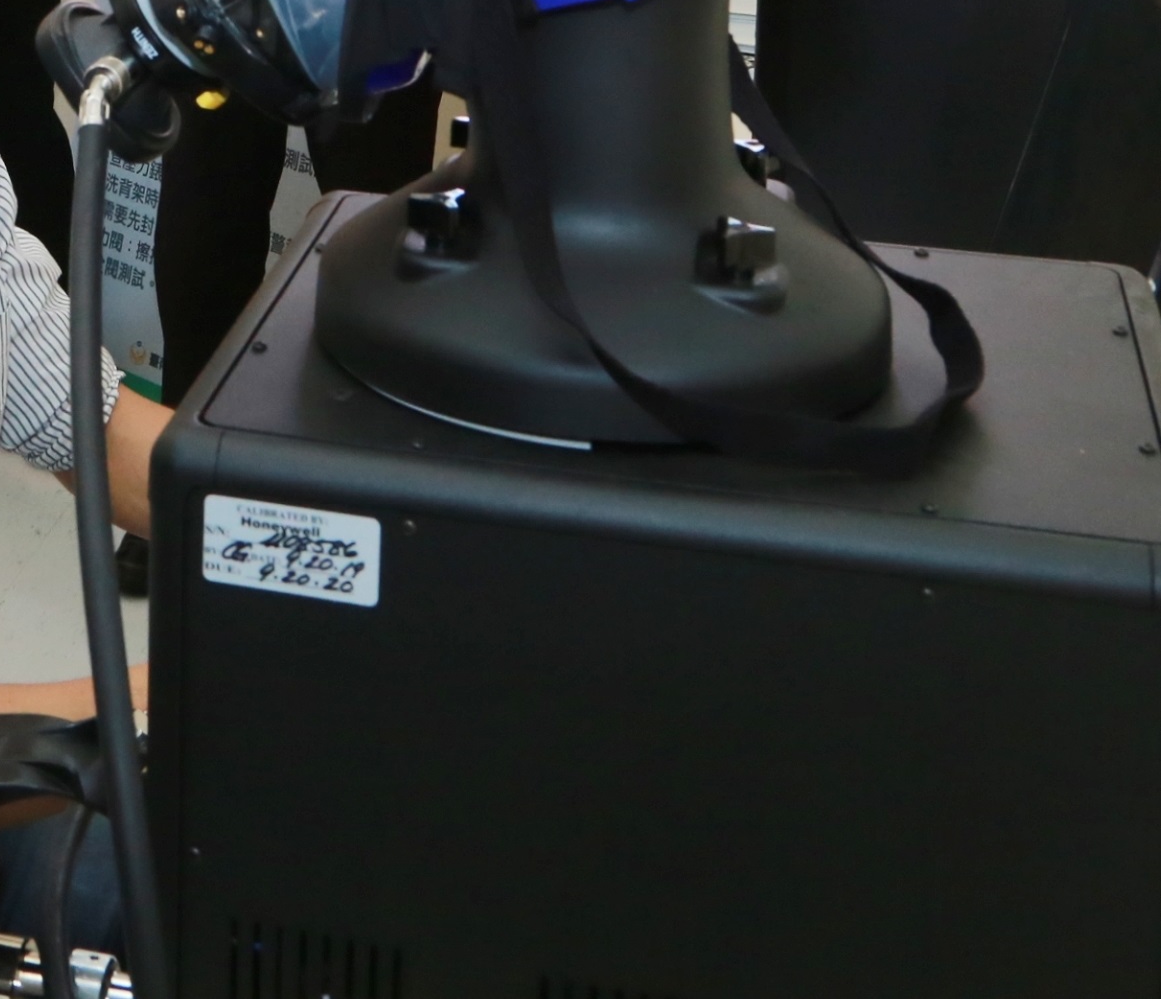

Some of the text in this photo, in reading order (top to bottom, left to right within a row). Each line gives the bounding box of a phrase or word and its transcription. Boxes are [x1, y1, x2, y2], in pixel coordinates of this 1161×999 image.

[284, 148, 316, 176] 測試
[102, 256, 155, 290] 閥測試。
[241, 515, 321, 539] Honeywell
